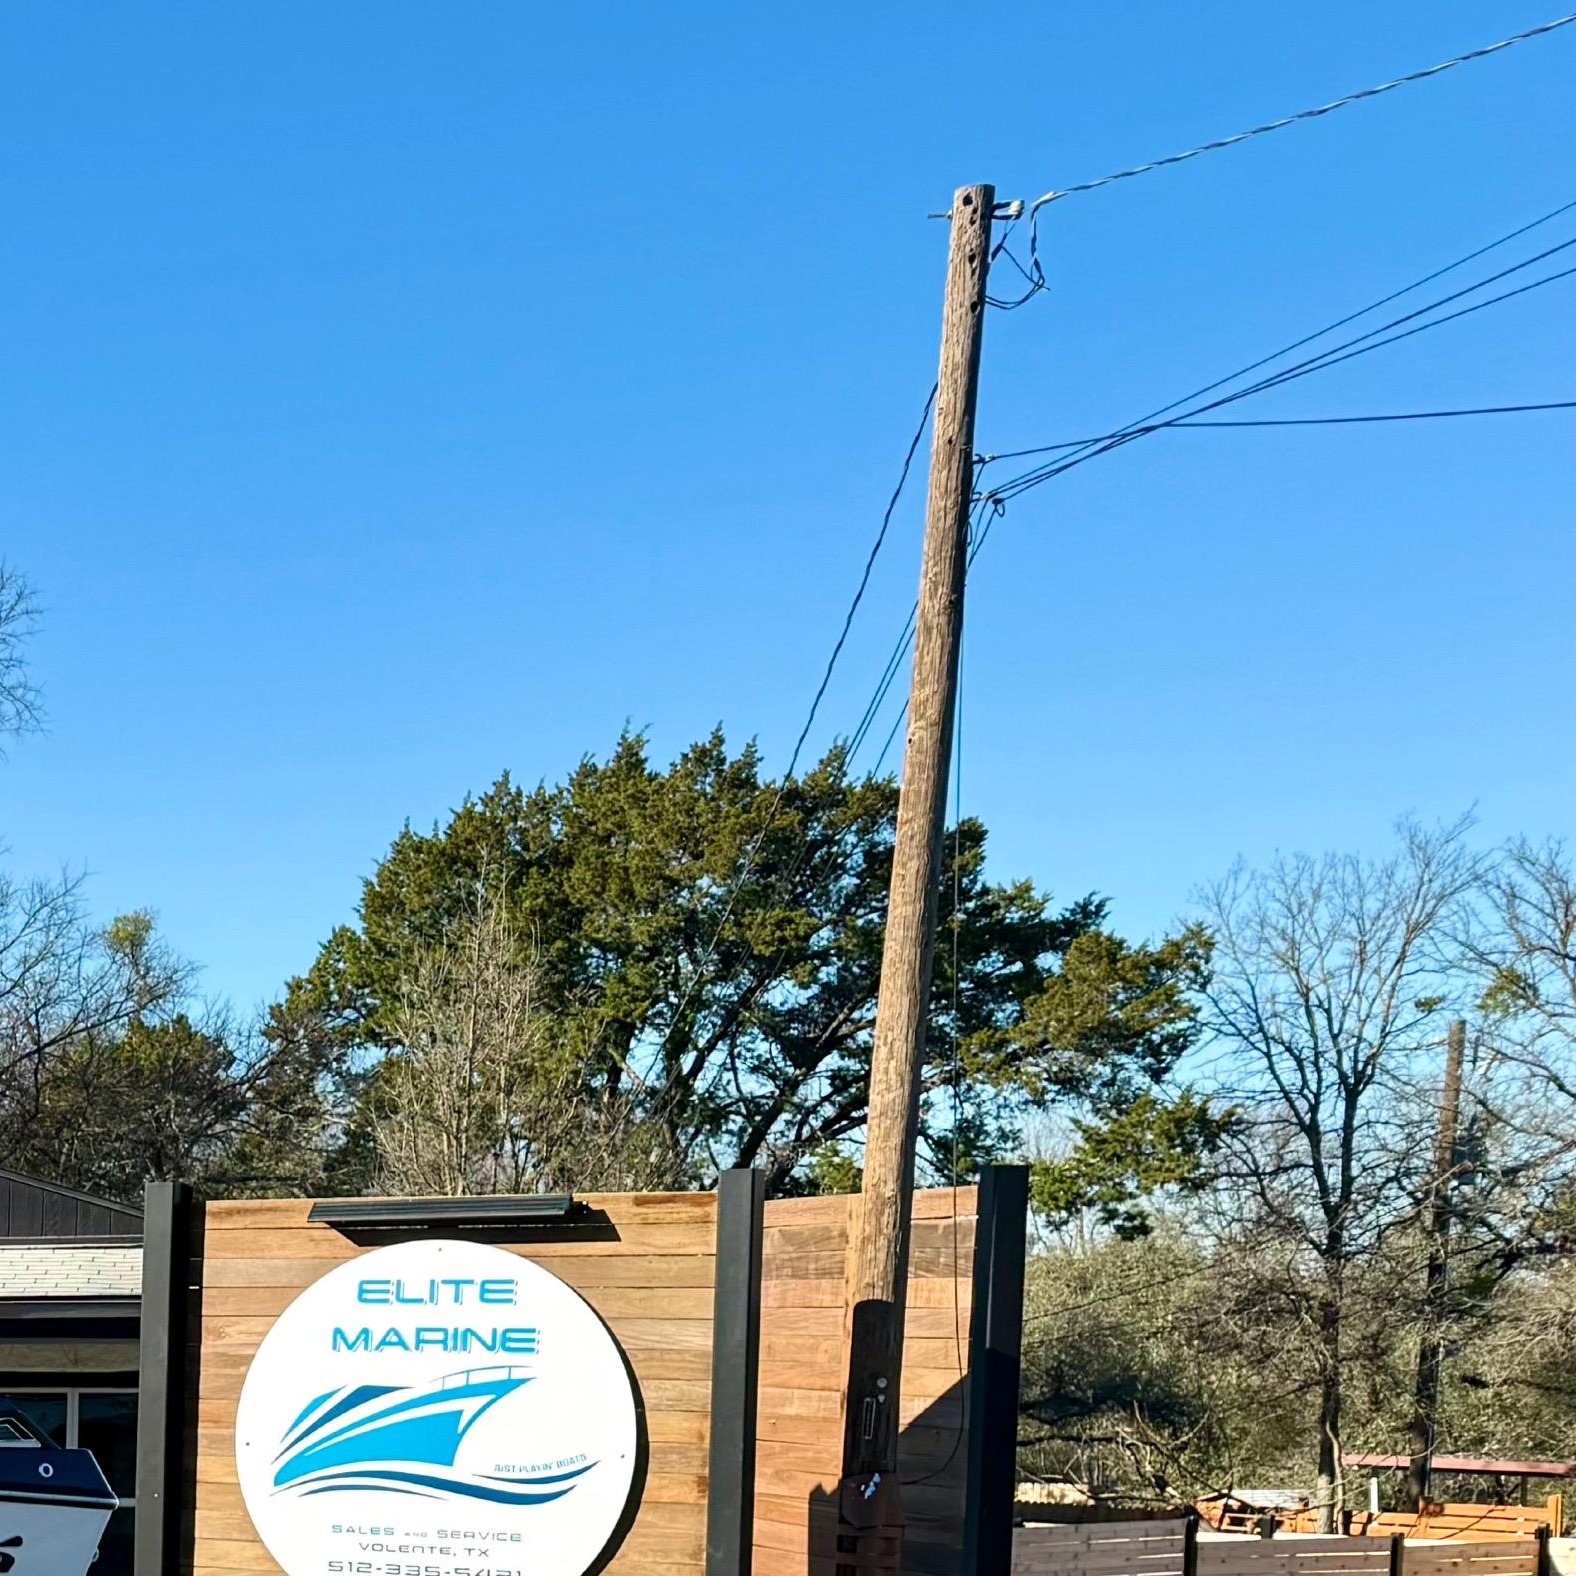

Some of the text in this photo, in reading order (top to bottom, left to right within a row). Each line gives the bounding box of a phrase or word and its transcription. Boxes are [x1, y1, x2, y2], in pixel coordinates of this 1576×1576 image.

[357, 1279, 518, 1305] ELITE
[332, 1327, 540, 1354] MARINE
[332, 1524, 395, 1536] SALES
[437, 1529, 522, 1542] SERVICE
[464, 1547, 489, 1557] TX
